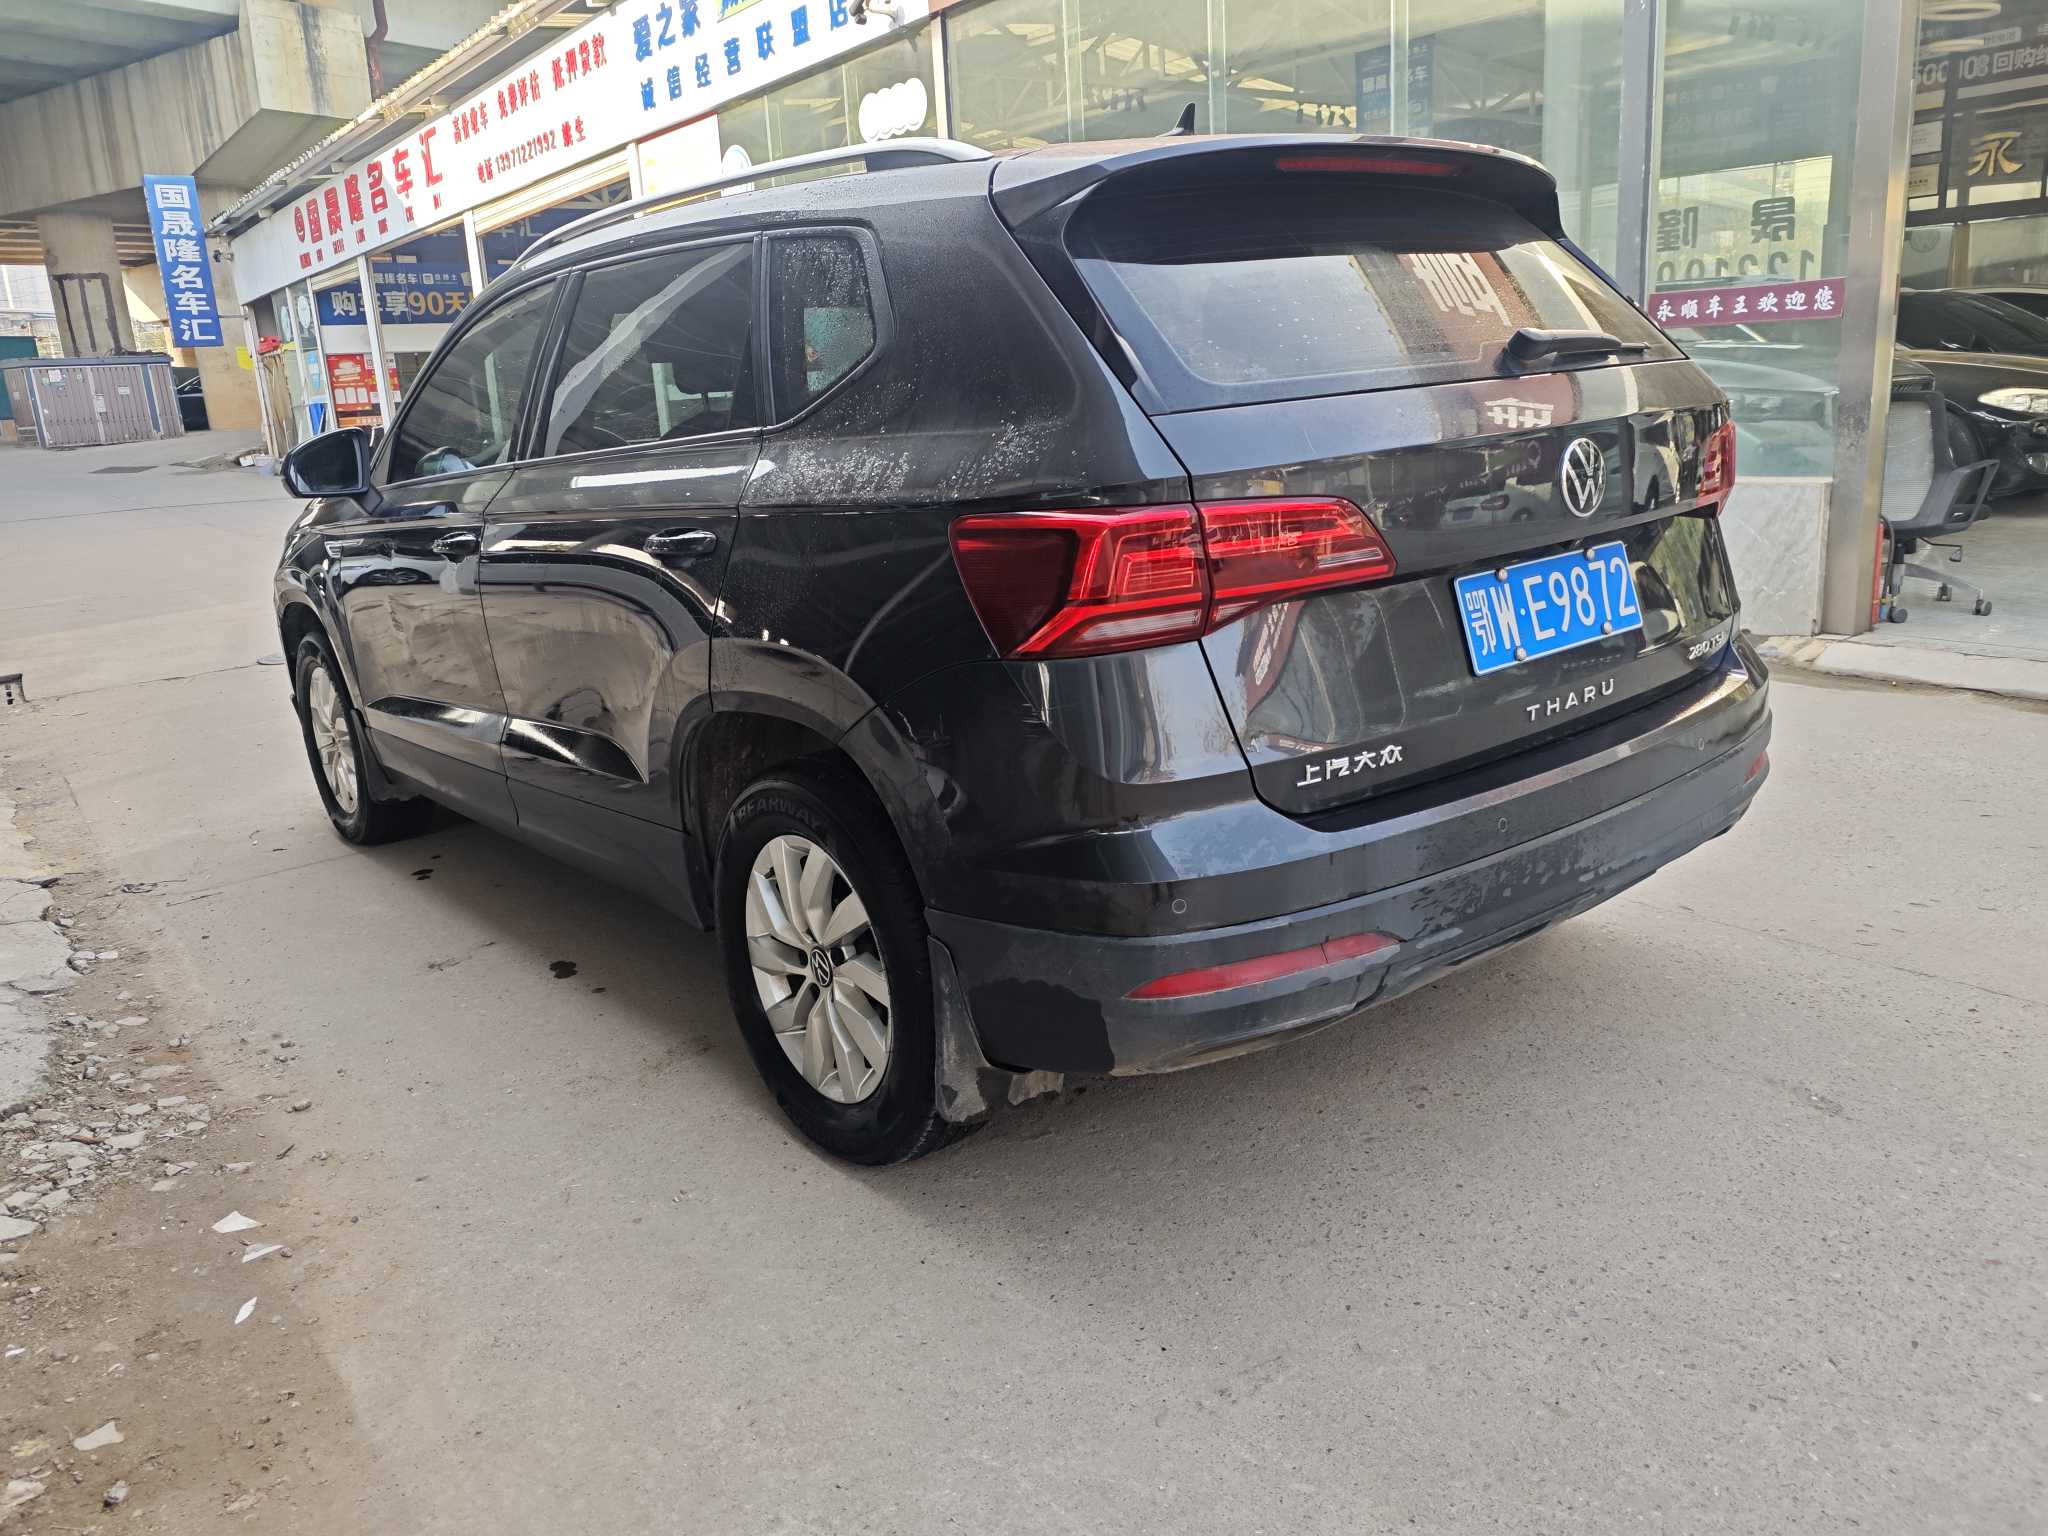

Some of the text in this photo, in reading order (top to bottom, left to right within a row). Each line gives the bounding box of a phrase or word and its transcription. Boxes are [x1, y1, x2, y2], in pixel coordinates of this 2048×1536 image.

[633, 0, 701, 62] 爱之家
[641, 0, 849, 110] 诚信经营联盟店
[452, 32, 607, 144] 高价收车 免费评估 抵押贷款
[477, 157, 493, 183] 电话
[496, 130, 557, 173] 13971221992
[1966, 131, 2024, 177] 永
[306, 127, 443, 244] 国晟隆名车汇
[154, 184, 216, 341] 国晟隆名车汇
[330, 290, 474, 317] 购享90天
[1656, 286, 1836, 322] 永顺车王欢迎您
[1687, 640, 1710, 660] 280
[1526, 678, 1616, 722] THARU
[1297, 744, 1404, 786] 上汽大众
